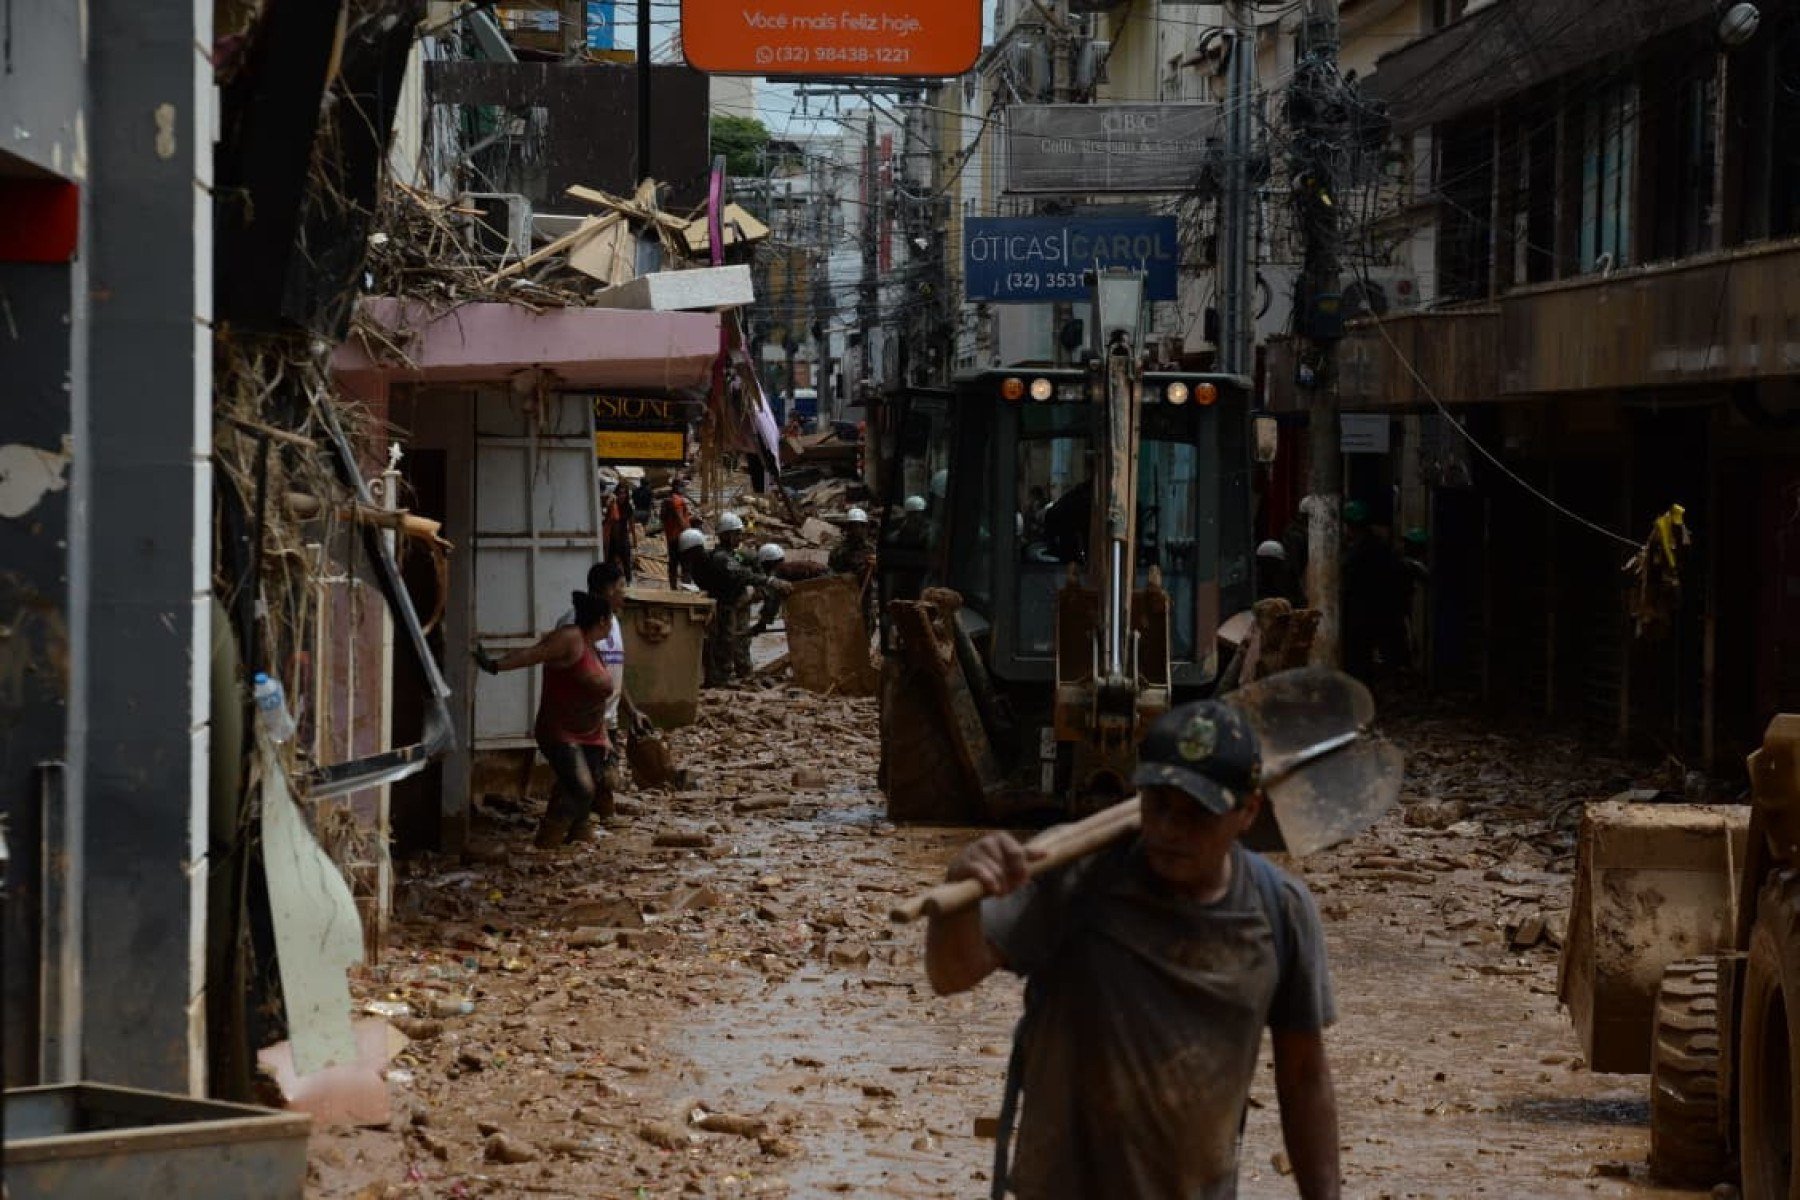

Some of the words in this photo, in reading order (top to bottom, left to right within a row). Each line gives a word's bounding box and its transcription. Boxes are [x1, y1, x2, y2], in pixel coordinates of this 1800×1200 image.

[742, 9, 786, 29] Você
[792, 13, 837, 29] mais
[841, 11, 878, 29] feliz
[882, 12, 923, 37] hoje.
[776, 46, 809, 64] (32)
[814, 47, 910, 63] 98438-1221
[970, 230, 1061, 262] ÓTICAS
[1072, 234, 1168, 260] CAROL
[1006, 272, 1040, 291] (32)
[1046, 273, 1086, 289] 3531
